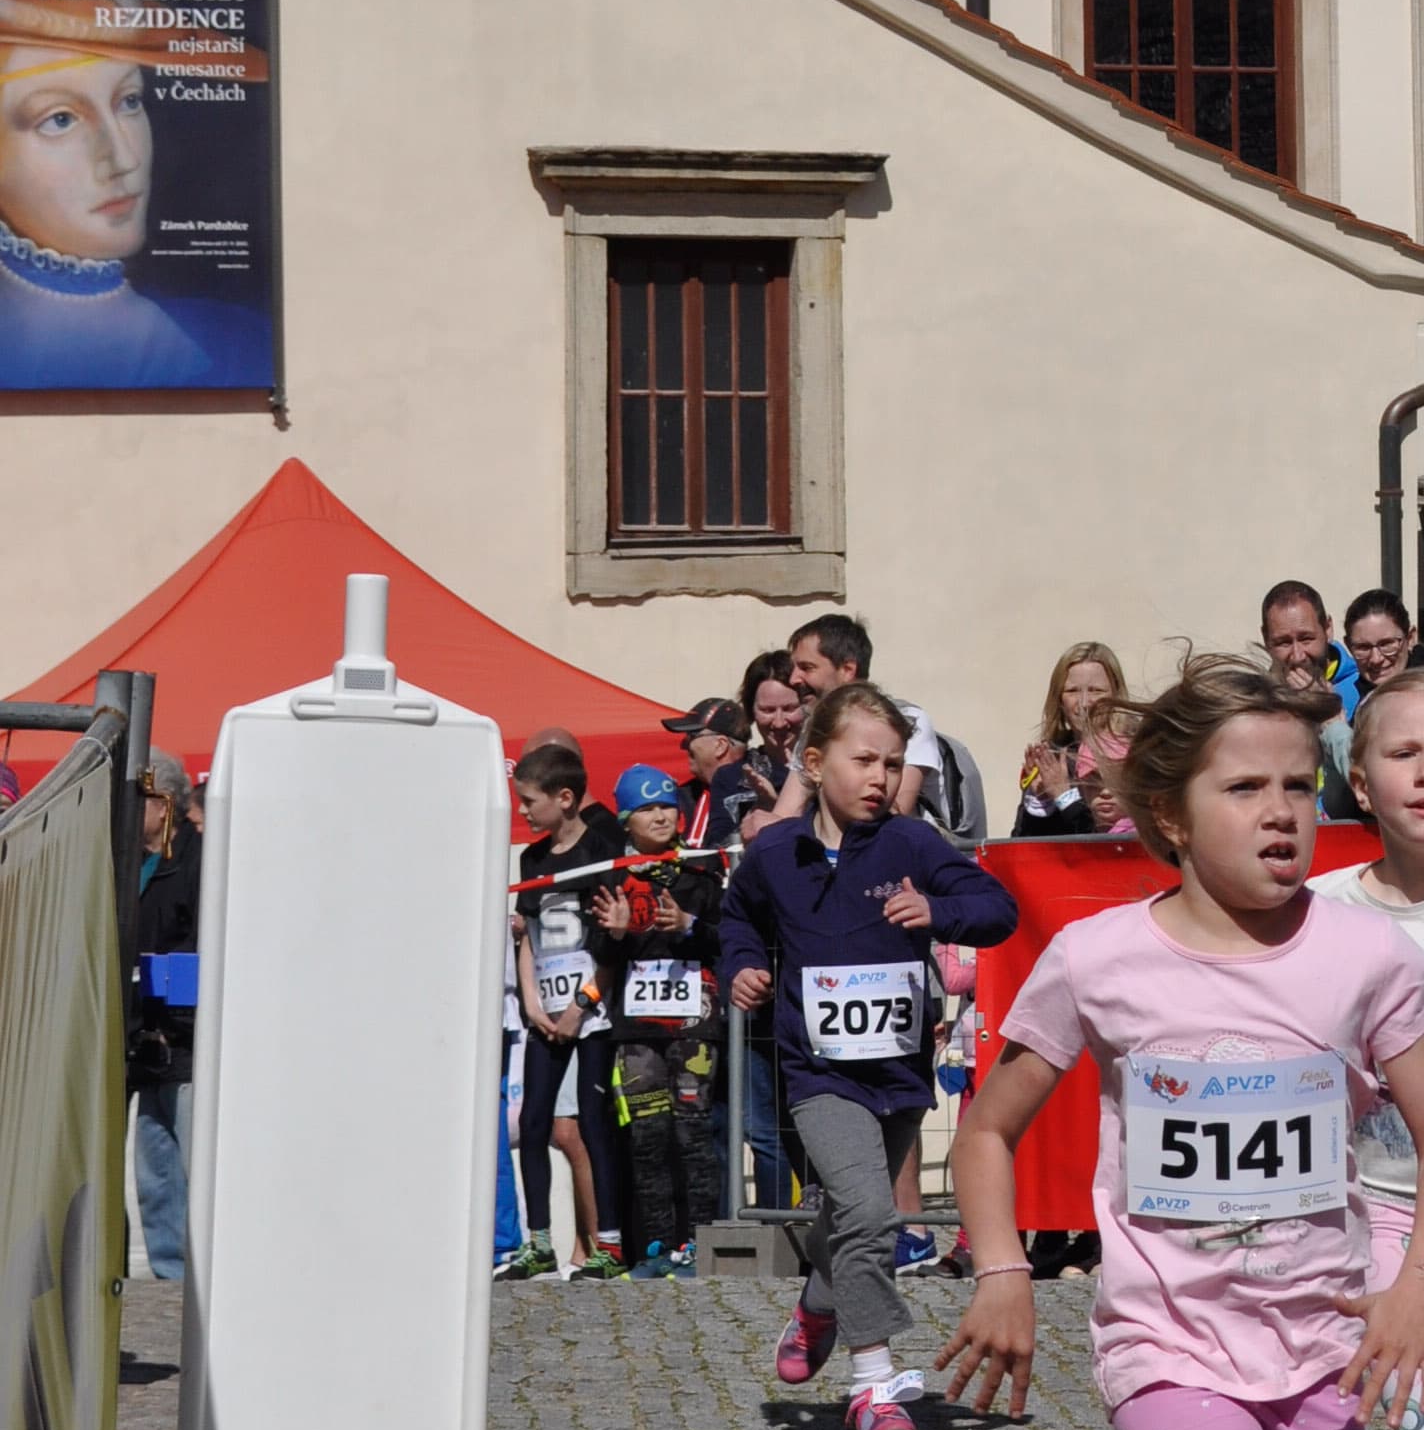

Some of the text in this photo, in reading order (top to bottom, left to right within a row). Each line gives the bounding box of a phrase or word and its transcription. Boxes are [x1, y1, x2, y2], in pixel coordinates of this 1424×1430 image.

[95, 7, 245, 29] REZIDENCE
[168, 35, 245, 56] nejstarší
[156, 63, 246, 77] renesance
[155, 81, 246, 101] v Čechách
[634, 981, 690, 1001] 2138
[818, 997, 913, 1035] 2073
[1227, 1074, 1276, 1091] PVZP
[1315, 1079, 1334, 1090] run
[1160, 1115, 1312, 1180] 5141
[1156, 1196, 1191, 1210] PVZP
[1232, 1201, 1272, 1213] Centrum
